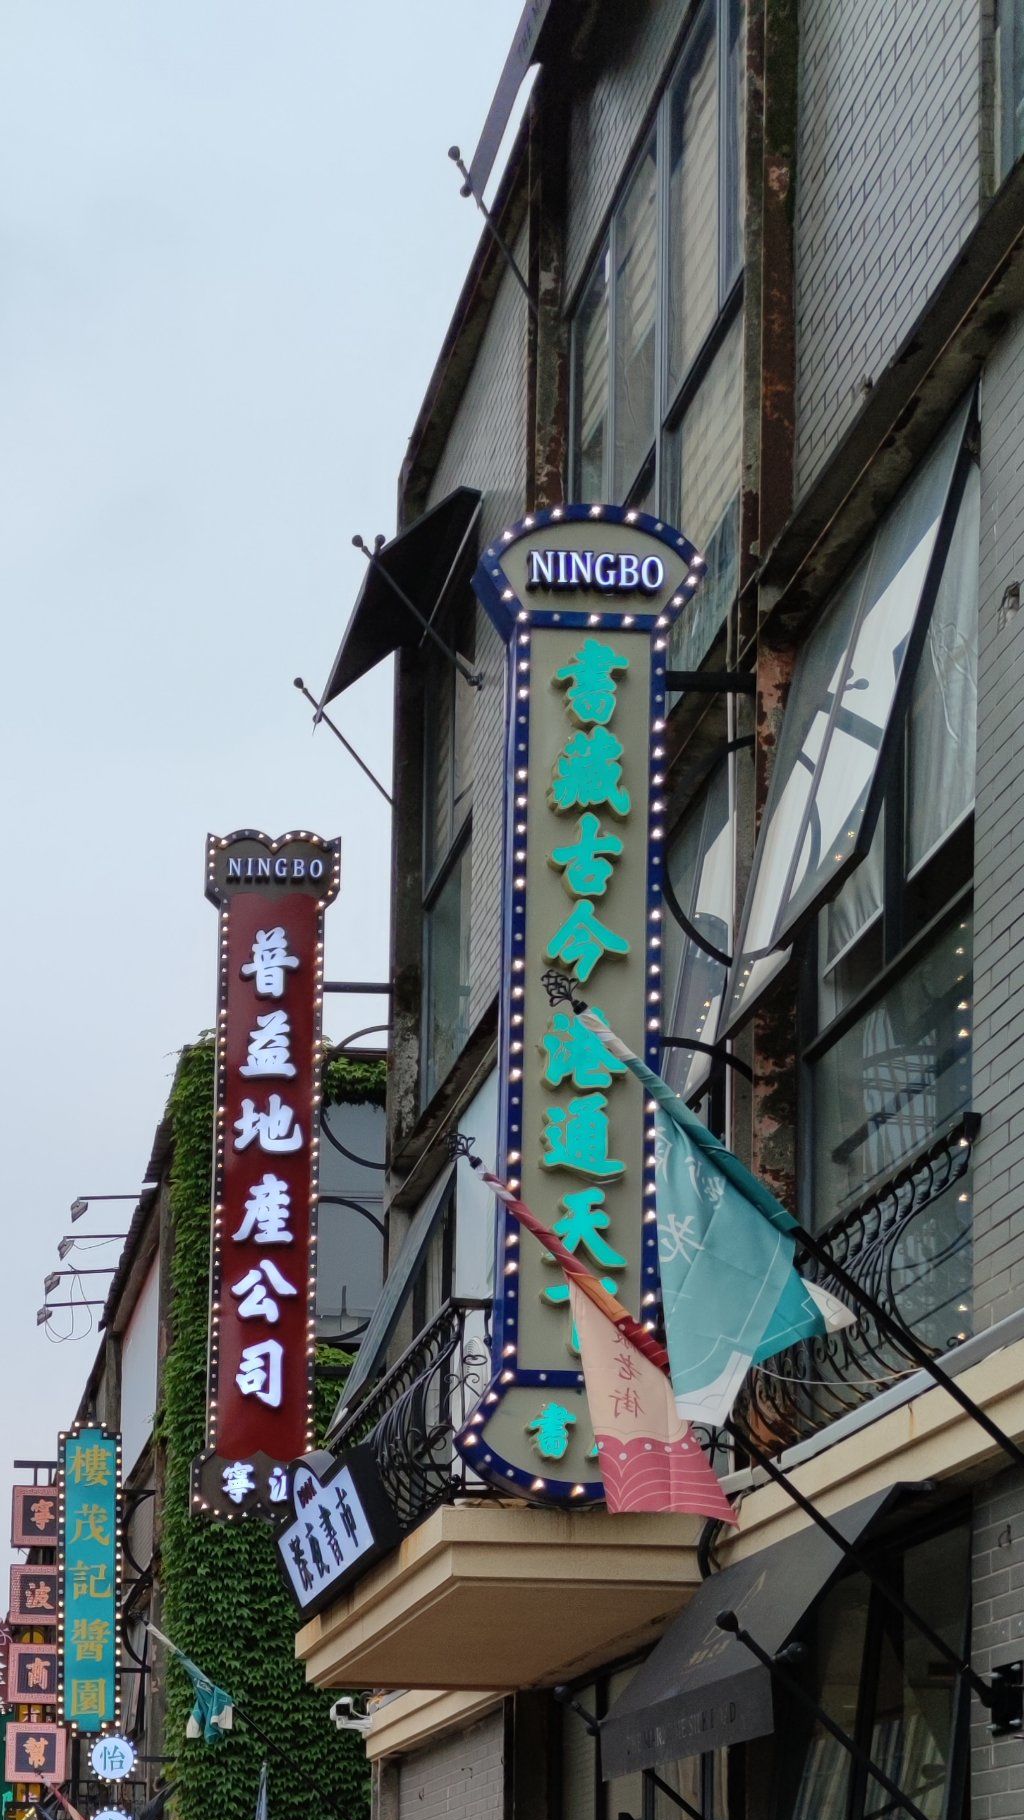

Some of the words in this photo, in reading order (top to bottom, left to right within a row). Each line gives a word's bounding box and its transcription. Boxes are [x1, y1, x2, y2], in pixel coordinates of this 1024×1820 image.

[530, 550, 664, 588] NINGBO
[227, 857, 323, 878] NINGBO
[542, 638, 630, 1352] 書藏古今港通天
[231, 926, 304, 1409] 普益地產公司
[68, 1444, 113, 1717] 樓茂記醬園
